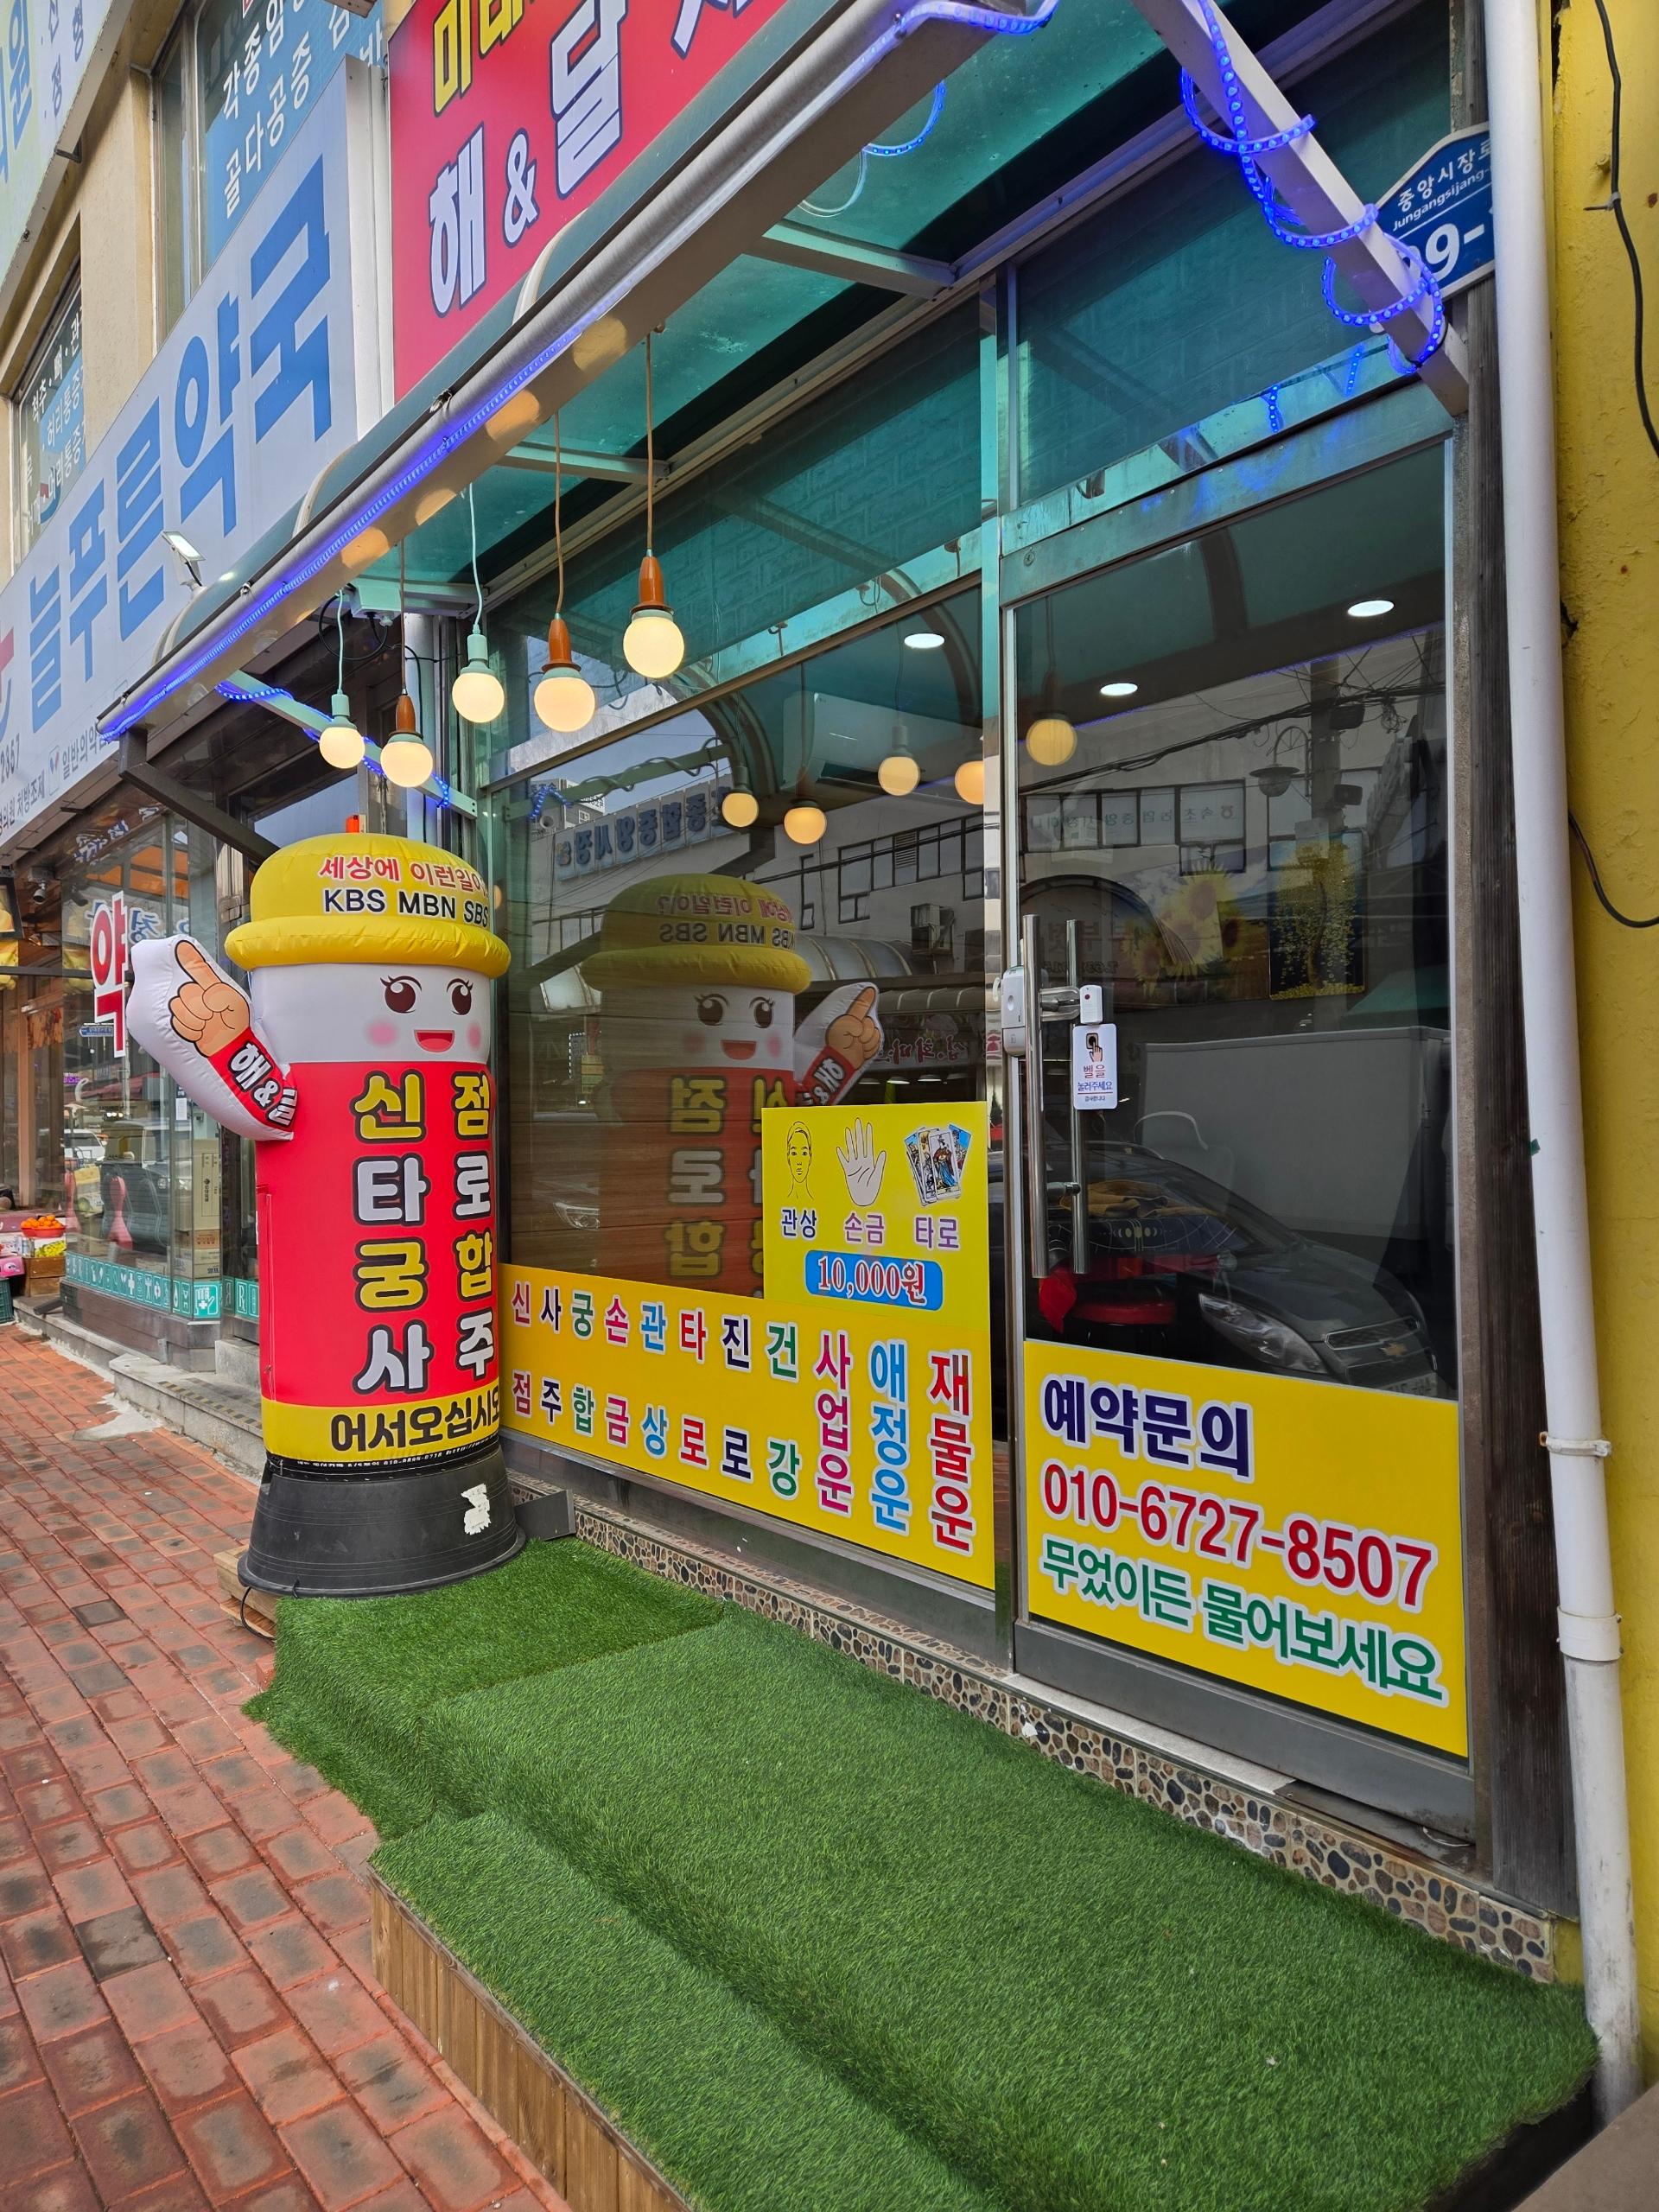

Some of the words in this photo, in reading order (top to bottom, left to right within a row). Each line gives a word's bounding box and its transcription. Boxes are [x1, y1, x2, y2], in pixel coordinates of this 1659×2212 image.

[224, 31, 312, 219] 골다공증
[29, 153, 332, 734] 늘푸른약국
[62, 721, 107, 781] 일반의약
[319, 855, 401, 882] 세상에
[410, 861, 489, 898] 이런일이
[324, 888, 386, 913] KBS
[398, 891, 456, 919] MBN
[463, 899, 489, 928] SBS
[92, 898, 127, 1052] 약
[1083, 1065, 1106, 1079] 벨을
[782, 1208, 817, 1240] 관상
[844, 1212, 886, 1246] 손금
[914, 1216, 960, 1250] 타로
[817, 1255, 927, 1306] 10,000원
[814, 1331, 853, 1516] 사업운
[869, 1339, 911, 1534] 애정운
[929, 1351, 975, 1555] 재물운
[1043, 1378, 1250, 1478] 예약문의
[1043, 1463, 1433, 1609] 010-6727-8507
[1202, 1580, 1444, 1702] 물어보세요
